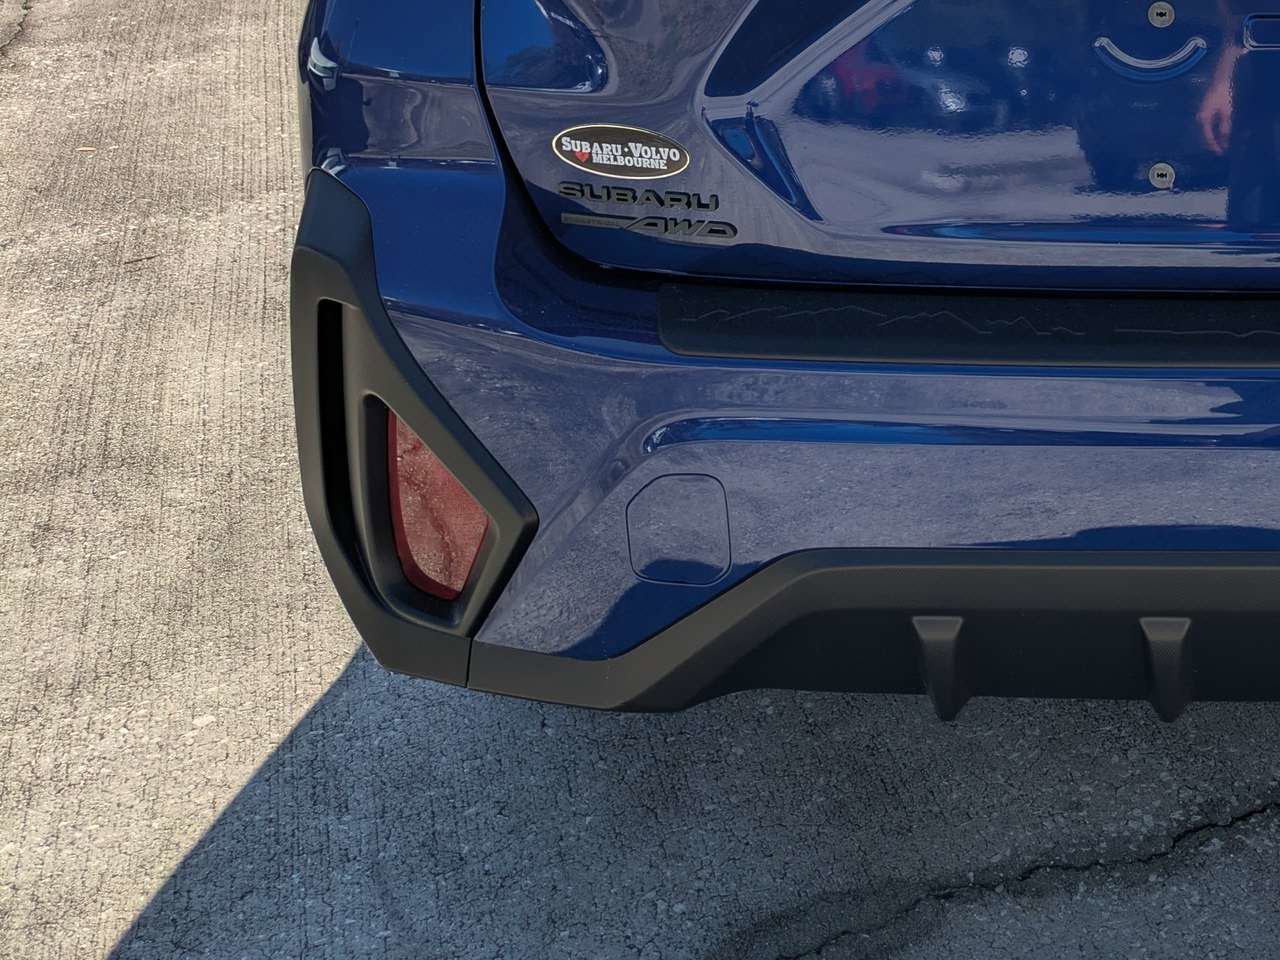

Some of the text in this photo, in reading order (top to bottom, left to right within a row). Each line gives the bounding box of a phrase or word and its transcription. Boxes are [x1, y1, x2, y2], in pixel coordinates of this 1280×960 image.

[561, 137, 680, 161] SUBARU VOLVO
[592, 153, 667, 169] MELBOURNE
[559, 181, 719, 211] SUBARU
[625, 215, 738, 238] AWD
